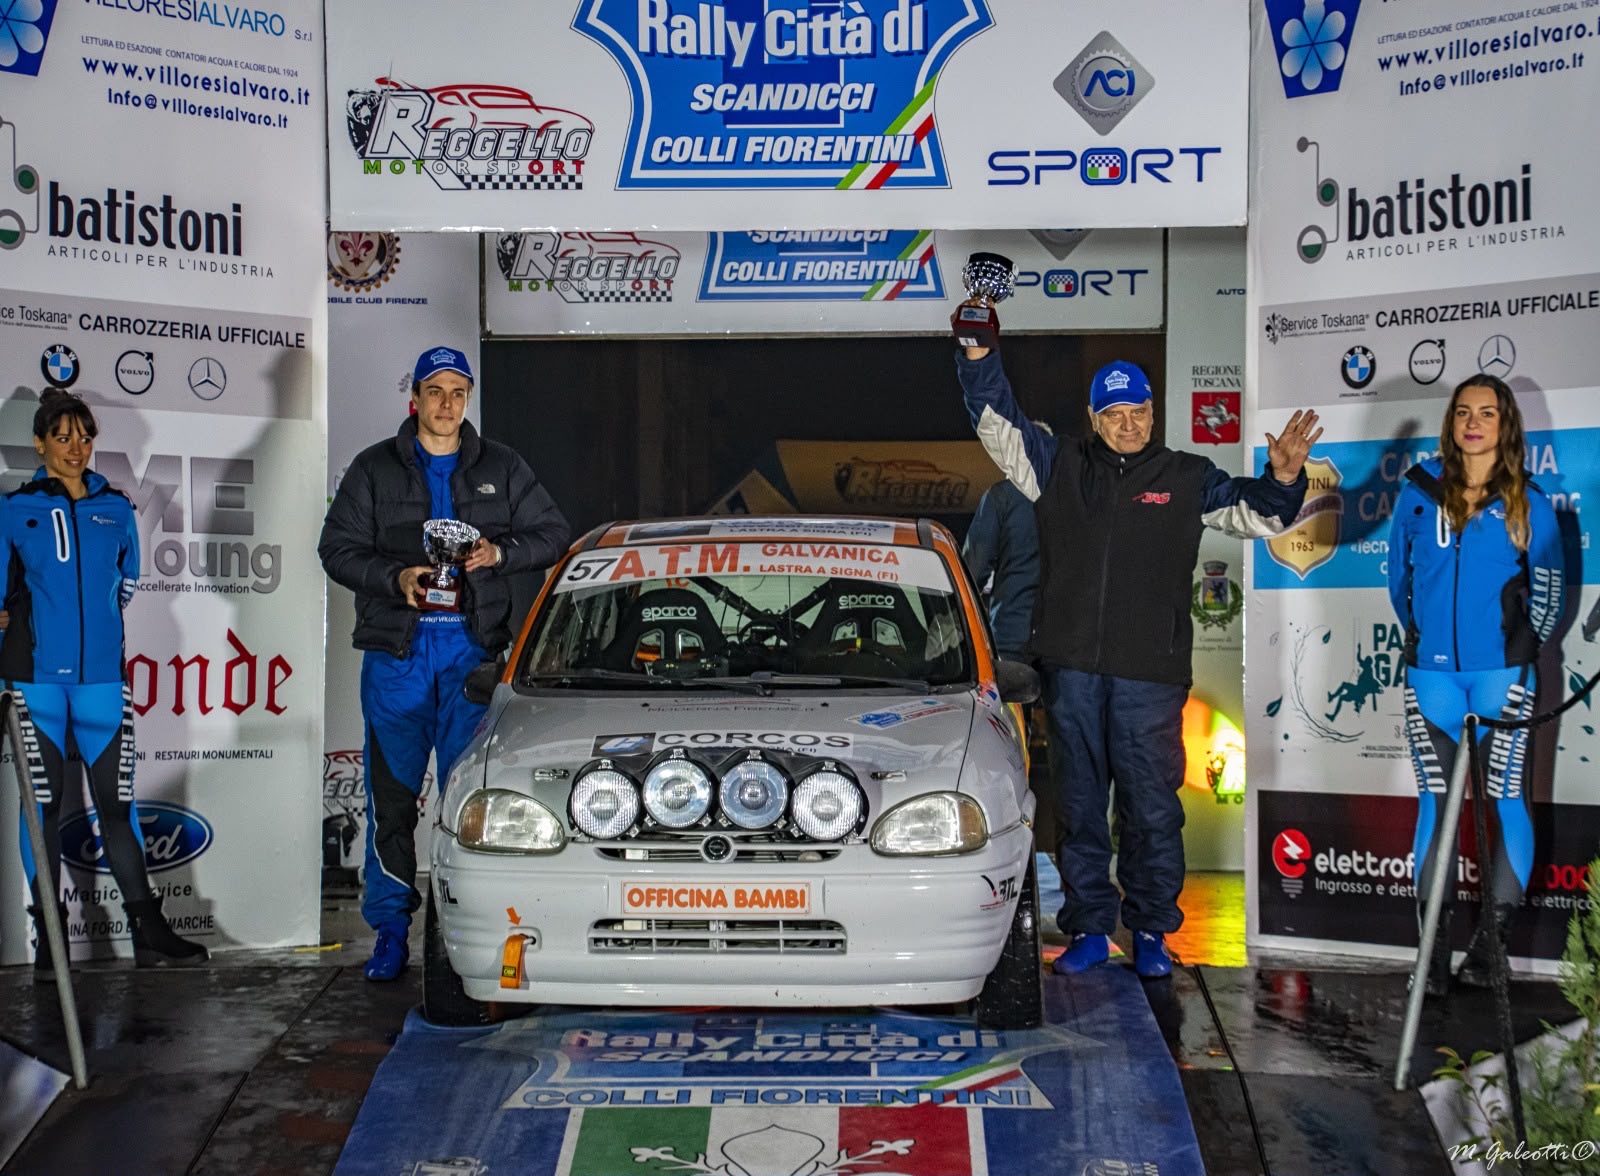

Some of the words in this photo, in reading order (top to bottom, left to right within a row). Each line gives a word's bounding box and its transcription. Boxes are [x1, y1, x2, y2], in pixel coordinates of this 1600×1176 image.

[638, 0, 757, 67] Rally
[764, 1, 874, 57] Città
[883, 0, 923, 52] di
[1377, 32, 1407, 45] LETTURA
[1407, 30, 1418, 39] ED
[1419, 23, 1453, 37] ESAZIONE
[1456, 16, 1497, 31] CONTATORI
[1498, 11, 1525, 23] ACQUA
[1532, 4, 1561, 17] CALORE
[1563, 2, 1579, 12] DAL
[81, 35, 114, 48] LETTURA
[115, 40, 126, 50] ED
[127, 43, 163, 56] ESAZIONE
[165, 49, 207, 63] CONTATORI
[208, 56, 233, 67] ACQUA
[240, 61, 266, 73] CALORE
[267, 65, 282, 75] DAL
[283, 68, 298, 77] 1924
[82, 57, 310, 106] www.villoresialvaro.it
[1083, 69, 1136, 97] ACI
[690, 83, 875, 112] SCANDICCI
[364, 89, 593, 189] REGGELLO
[651, 136, 738, 163] COLLI
[744, 135, 916, 162] FIORENTINI
[987, 147, 1222, 186] SPORT
[1348, 163, 1532, 242] batistoni
[49, 180, 243, 257] batistoni
[1346, 242, 1420, 261] ARTICOLI
[1427, 239, 1458, 253] PER
[1468, 226, 1566, 248] L'INDUSTRIA
[47, 244, 129, 264] ARTICOLI
[136, 253, 168, 268] PER
[178, 258, 274, 278] L'INDUSTRIA
[513, 232, 680, 302] REGGELLO
[723, 260, 788, 282] COLLI
[792, 258, 921, 281] FIORENTINI
[1015, 269, 1149, 298] PORT
[1375, 300, 1502, 328] CARROZZERIA
[1508, 290, 1600, 317] UFFICIALE
[78, 313, 212, 341] CARROZZERIA
[218, 326, 306, 349] UFFICIALE
[1281, 315, 1318, 332] Service
[120, 368, 150, 377] VOLVO
[1191, 365, 1242, 376] REGIONE
[1413, 358, 1442, 367] VOLVO
[1191, 377, 1242, 388] TOSCANA
[761, 543, 900, 566] GALVANICA
[1291, 541, 1315, 552] 1963
[567, 558, 617, 582] 57
[609, 544, 751, 581] A.T.M.
[759, 564, 814, 574] LASTRA
[816, 565, 826, 574] A
[830, 567, 873, 579] SIGNA
[876, 569, 899, 582] (FI)
[194, 579, 250, 594] Innovation
[642, 606, 697, 621] sparco
[841, 594, 895, 610] sparco
[658, 732, 853, 748] CORCOS
[154, 750, 200, 761] RESTAURI
[202, 749, 273, 760] MONUMENTALI
[627, 887, 728, 909] OFFICINA
[733, 886, 806, 909] BAMBI
[1315, 877, 1372, 896] Ingrosso
[1376, 884, 1385, 895] e
[560, 1029, 729, 1051] Rally
[754, 1029, 920, 1048] Città
[932, 1029, 1000, 1048] di
[594, 1050, 968, 1063] SCANDICCI
[522, 1088, 689, 1106] COLLI
[710, 1088, 1032, 1106] FIORENTINI
